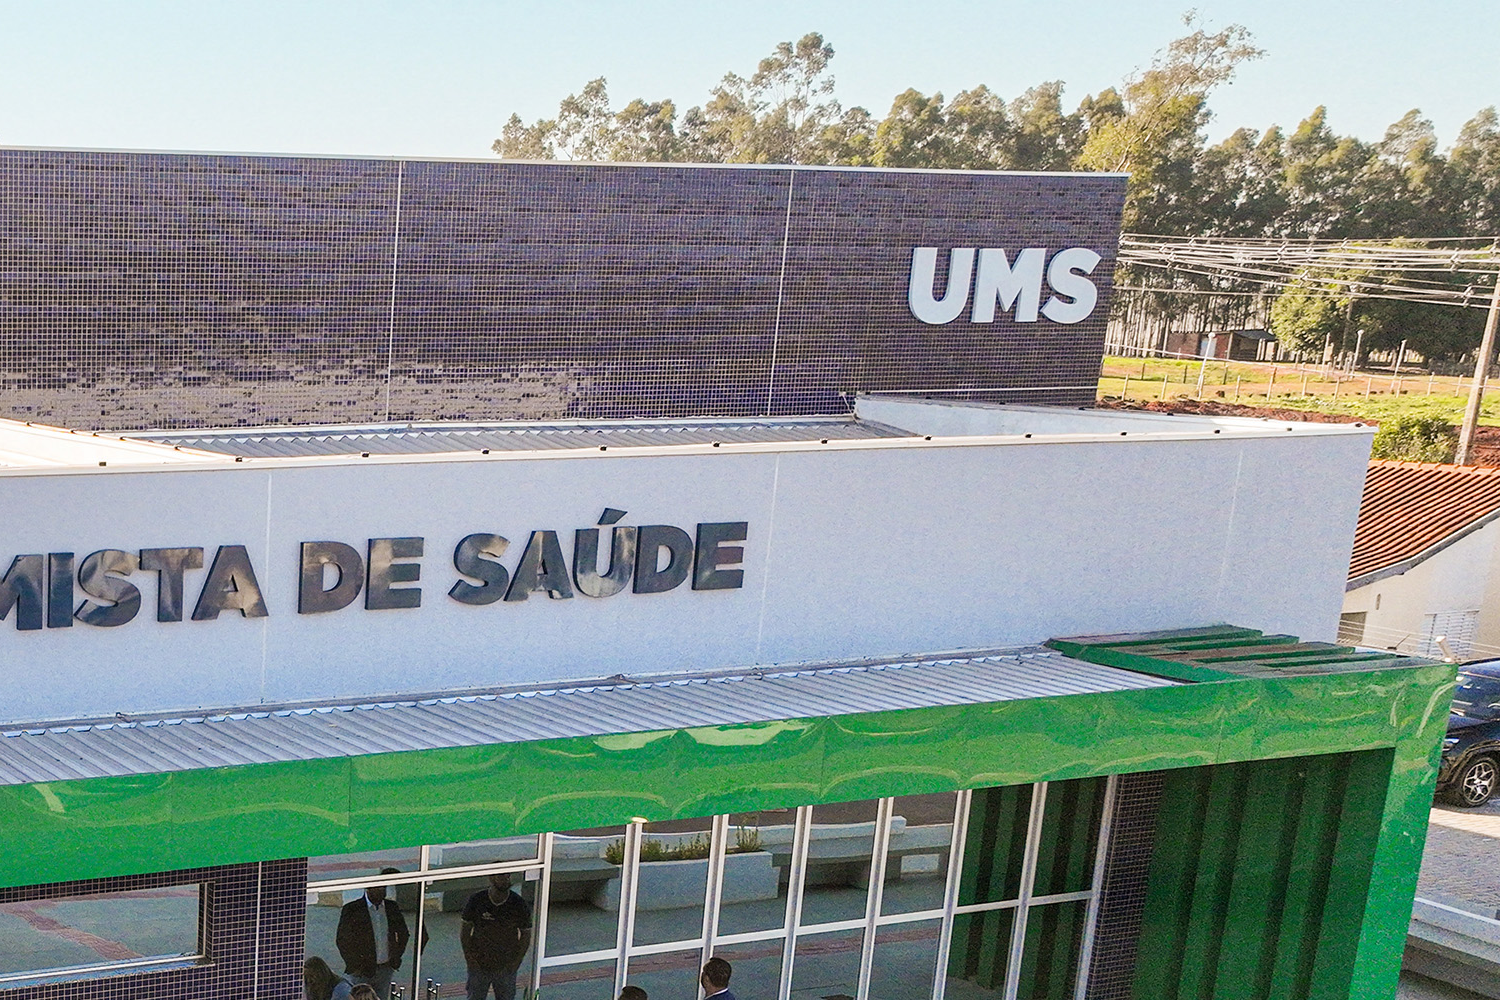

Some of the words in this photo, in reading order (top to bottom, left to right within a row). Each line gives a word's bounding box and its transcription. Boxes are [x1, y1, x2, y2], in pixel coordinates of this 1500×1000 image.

[908, 246, 1102, 325] UMS
[298, 536, 425, 615] DE
[448, 507, 749, 606] SAÚDE
